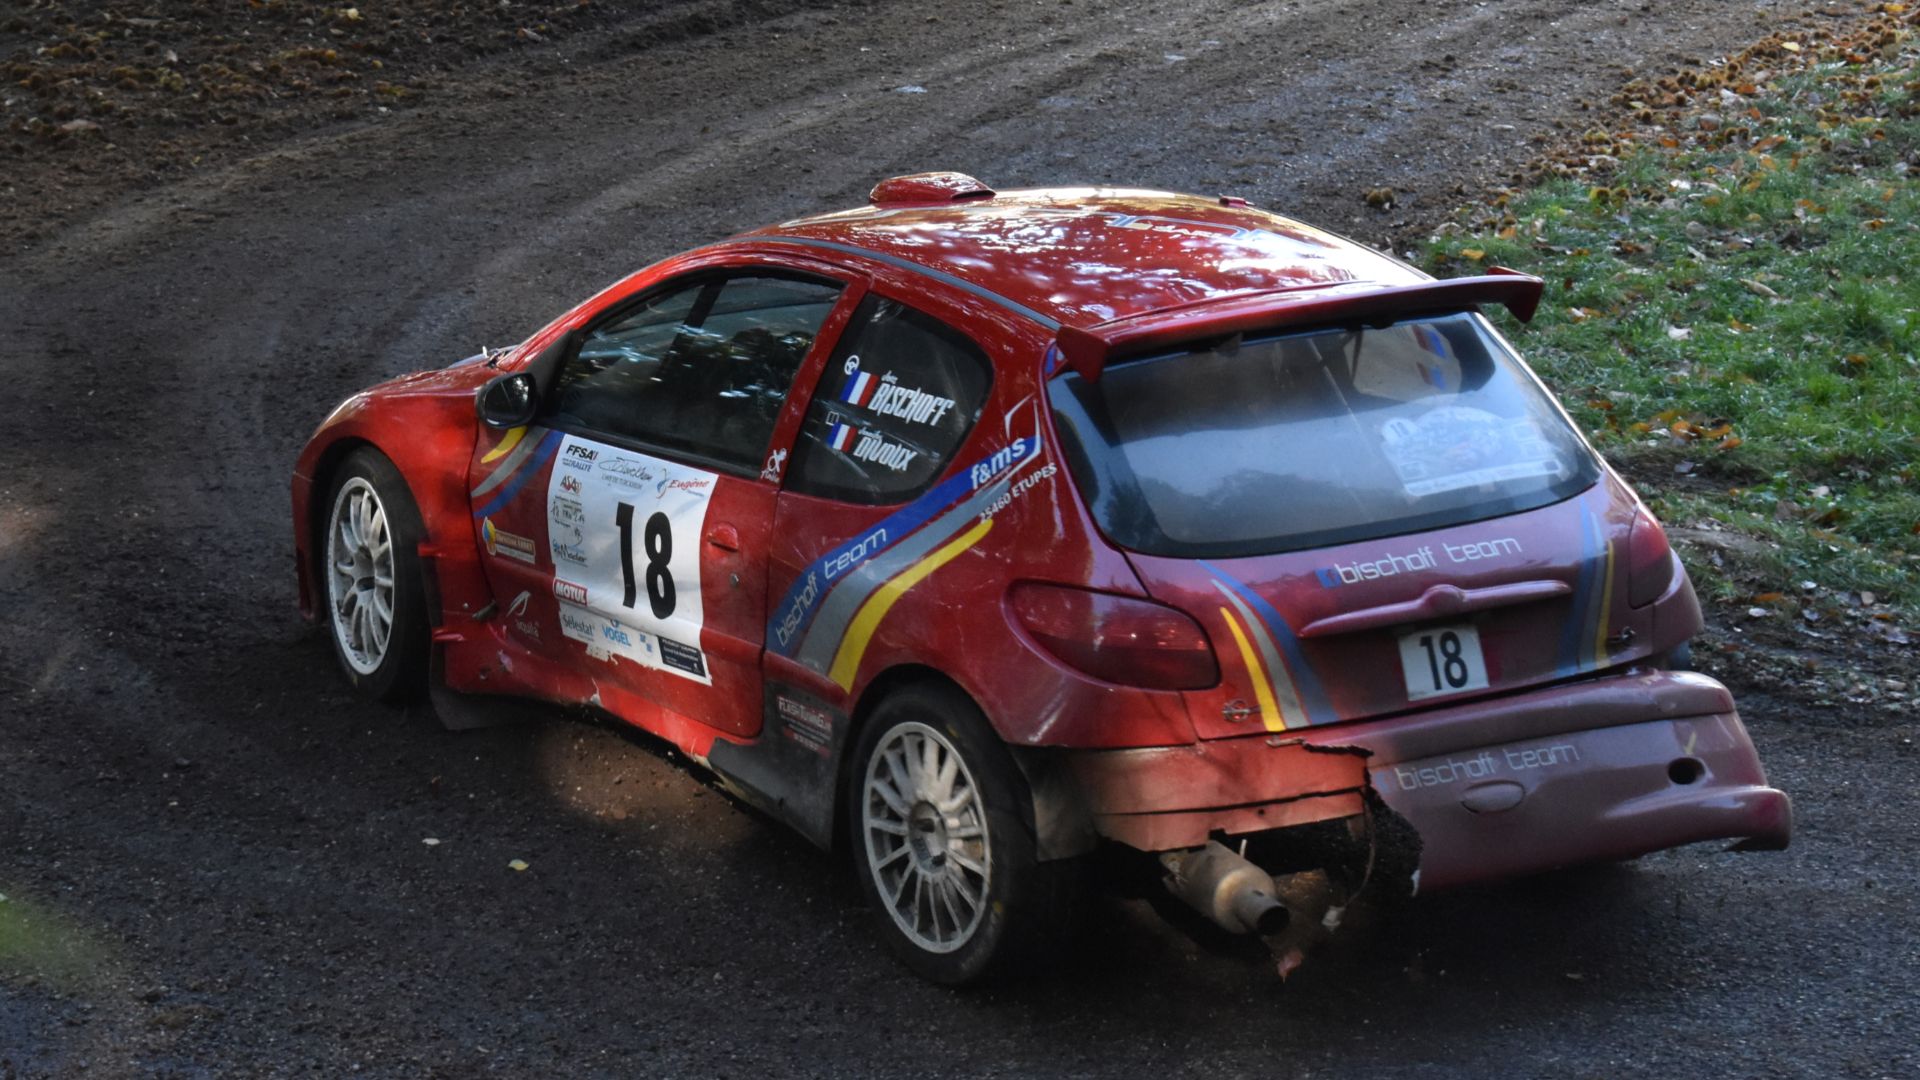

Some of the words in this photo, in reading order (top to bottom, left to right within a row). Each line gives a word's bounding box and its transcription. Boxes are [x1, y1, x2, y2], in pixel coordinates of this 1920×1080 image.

[868, 383, 956, 426] BISCHOFF
[566, 444, 594, 460] FFSA
[980, 493, 1011, 523] 25460
[1012, 462, 1057, 498] ETUPES
[616, 501, 676, 620] 18
[1335, 546, 1437, 584] bischoff
[1443, 537, 1522, 563] team
[556, 582, 586, 604] MOTUL
[776, 571, 818, 647] bischoff
[824, 528, 886, 579] team
[602, 624, 632, 647] VOGEL
[1420, 631, 1468, 691] 18
[1395, 752, 1495, 790] bischoff
[1503, 744, 1580, 771] team
